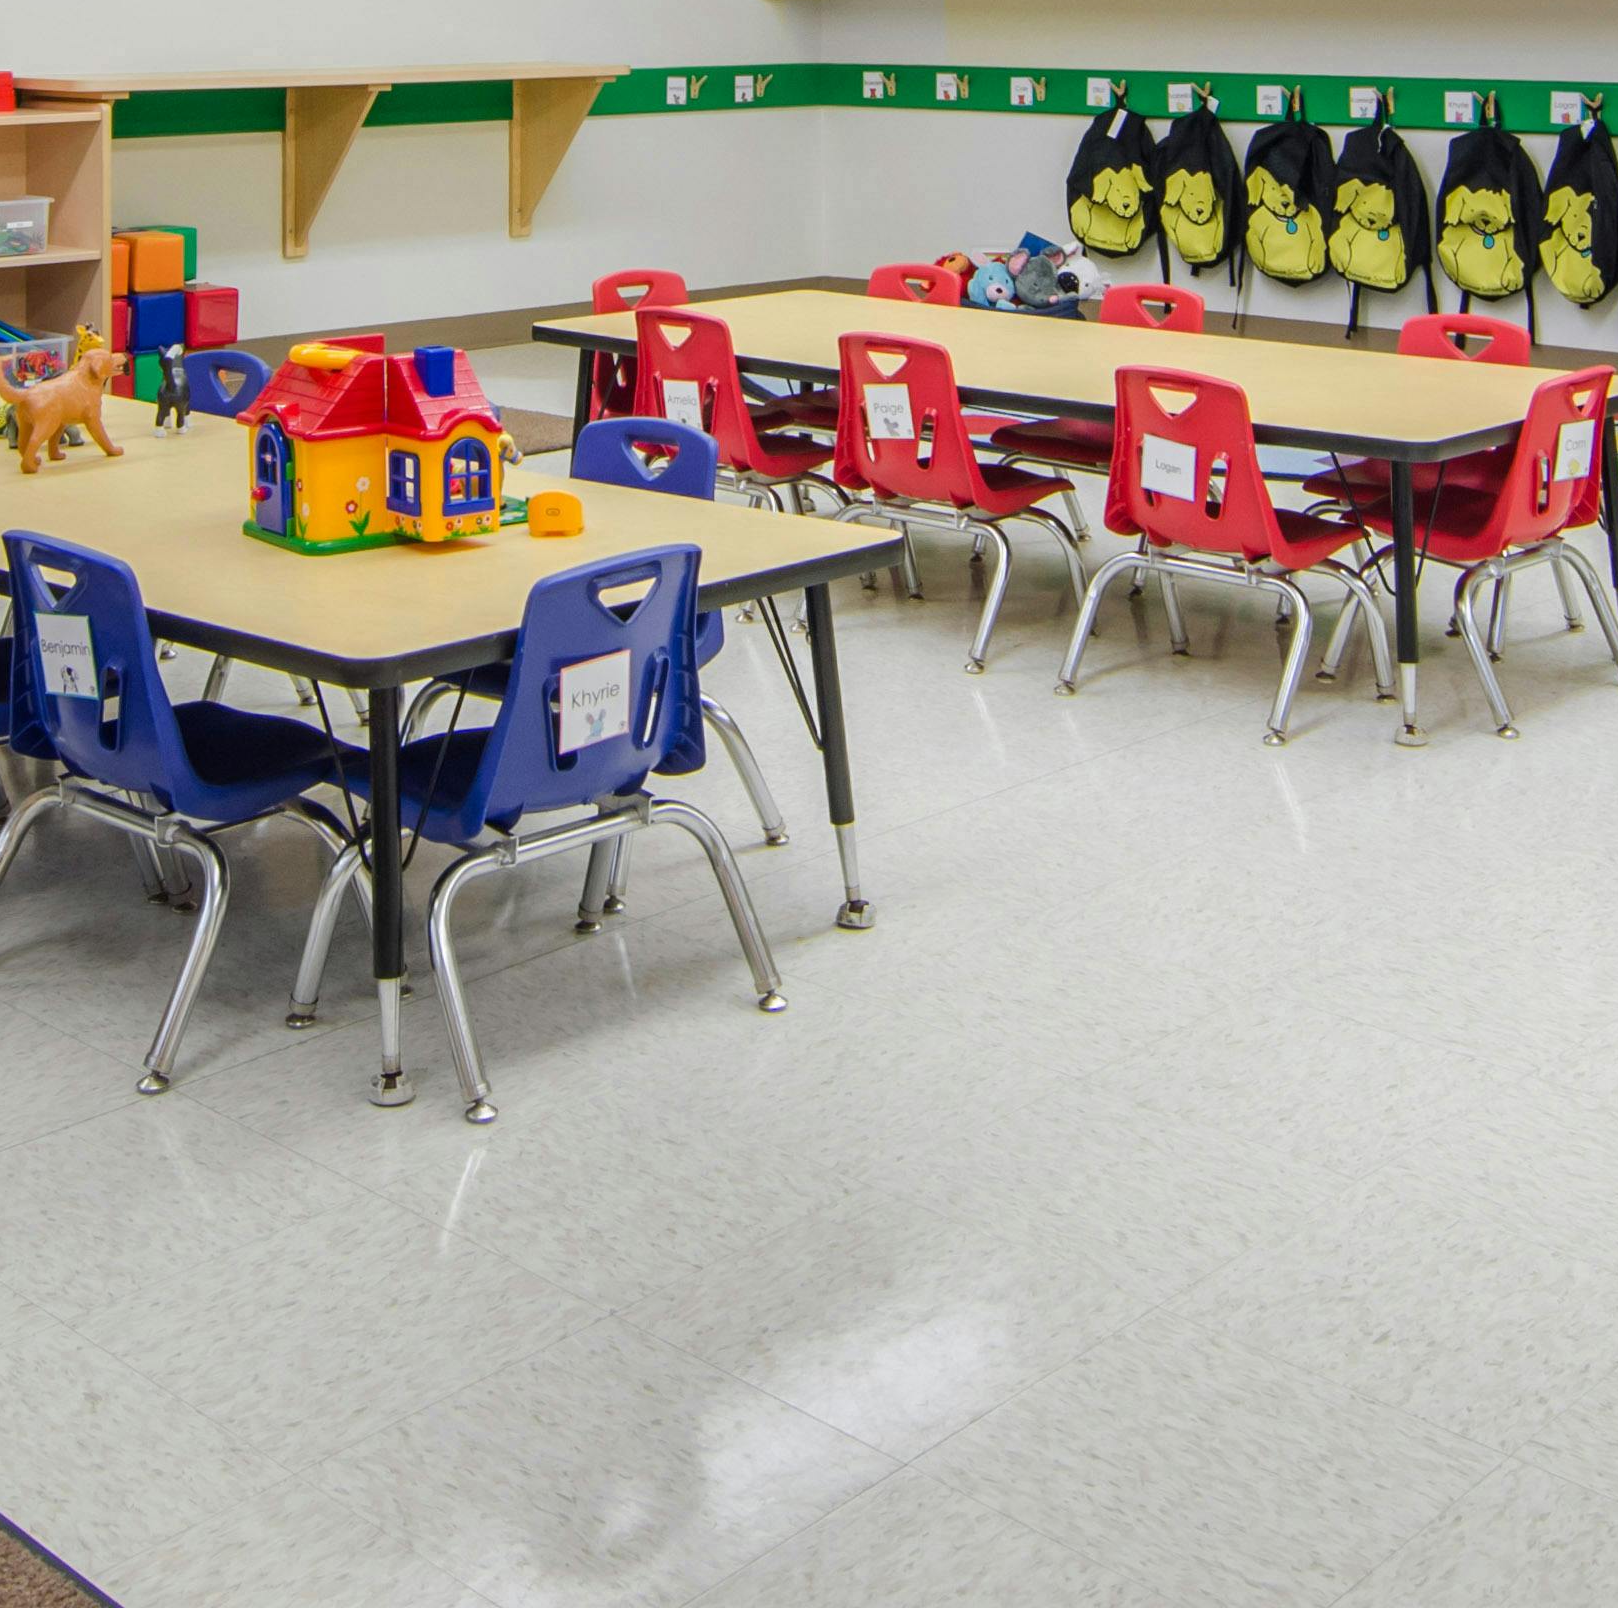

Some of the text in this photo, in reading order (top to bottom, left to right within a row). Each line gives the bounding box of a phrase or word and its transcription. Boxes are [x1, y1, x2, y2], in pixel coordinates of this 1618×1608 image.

[1554, 101, 1578, 110] Logan
[667, 394, 698, 407] Amelia
[873, 402, 904, 417] Paige
[1155, 458, 1182, 475] Logan
[40, 638, 91, 658] Benjamin
[571, 681, 621, 708] Khyrie
